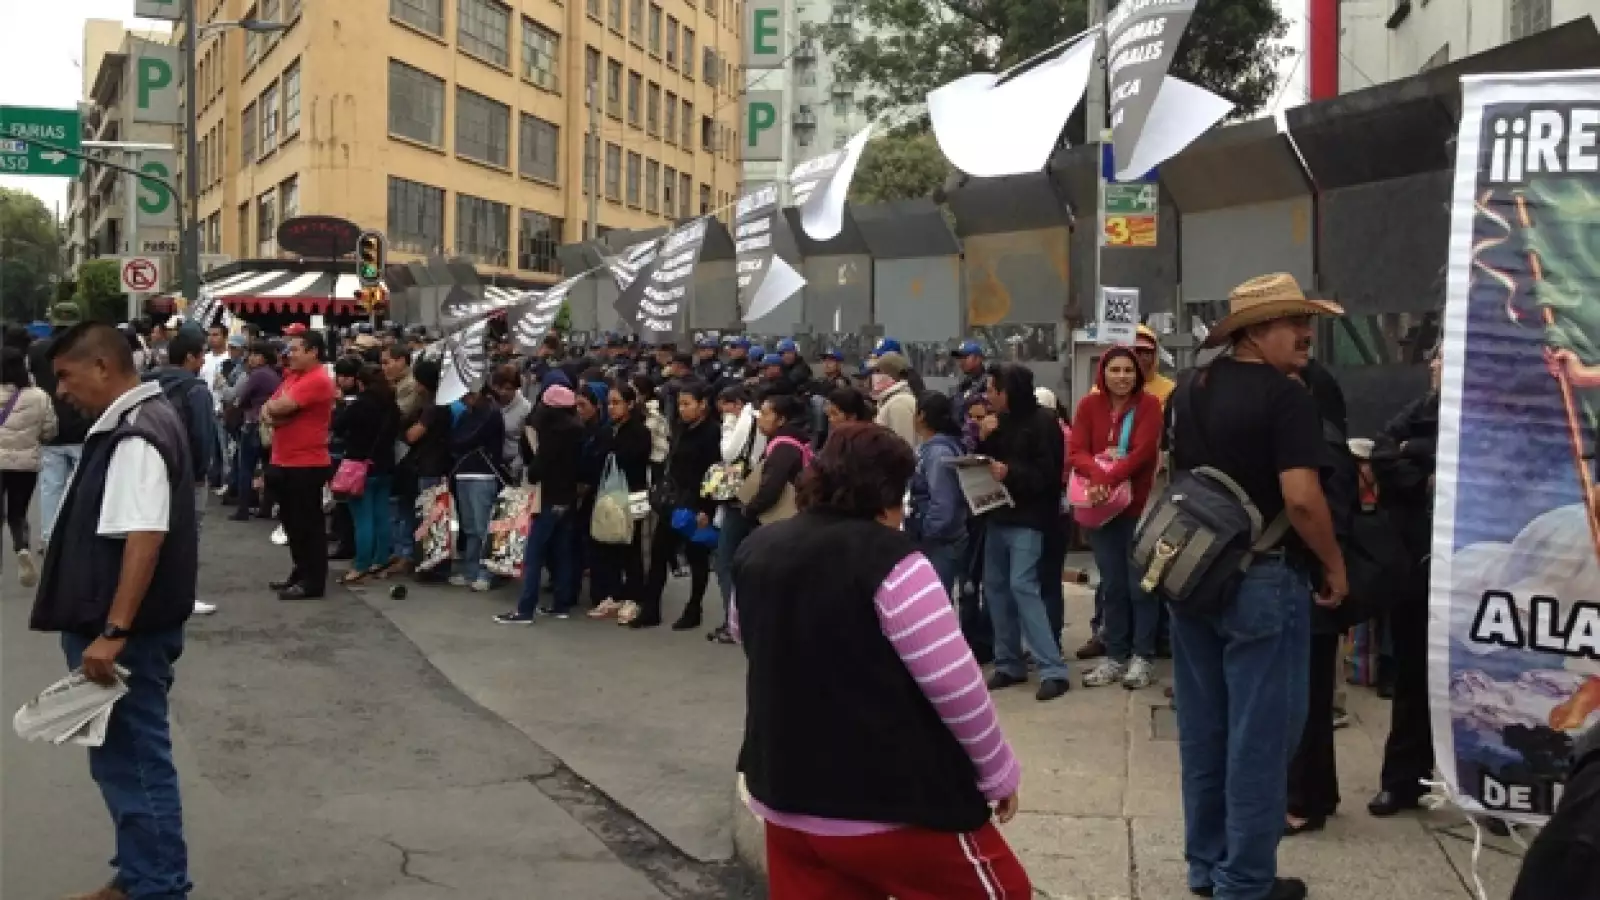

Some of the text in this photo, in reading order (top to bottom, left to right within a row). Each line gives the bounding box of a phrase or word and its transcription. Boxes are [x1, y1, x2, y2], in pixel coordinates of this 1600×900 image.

[753, 9, 778, 54] E
[136, 58, 173, 109] P
[747, 102, 776, 147] P
[137, 161, 171, 215] S
[1472, 591, 1522, 647] A
[1482, 773, 1533, 811] DE
